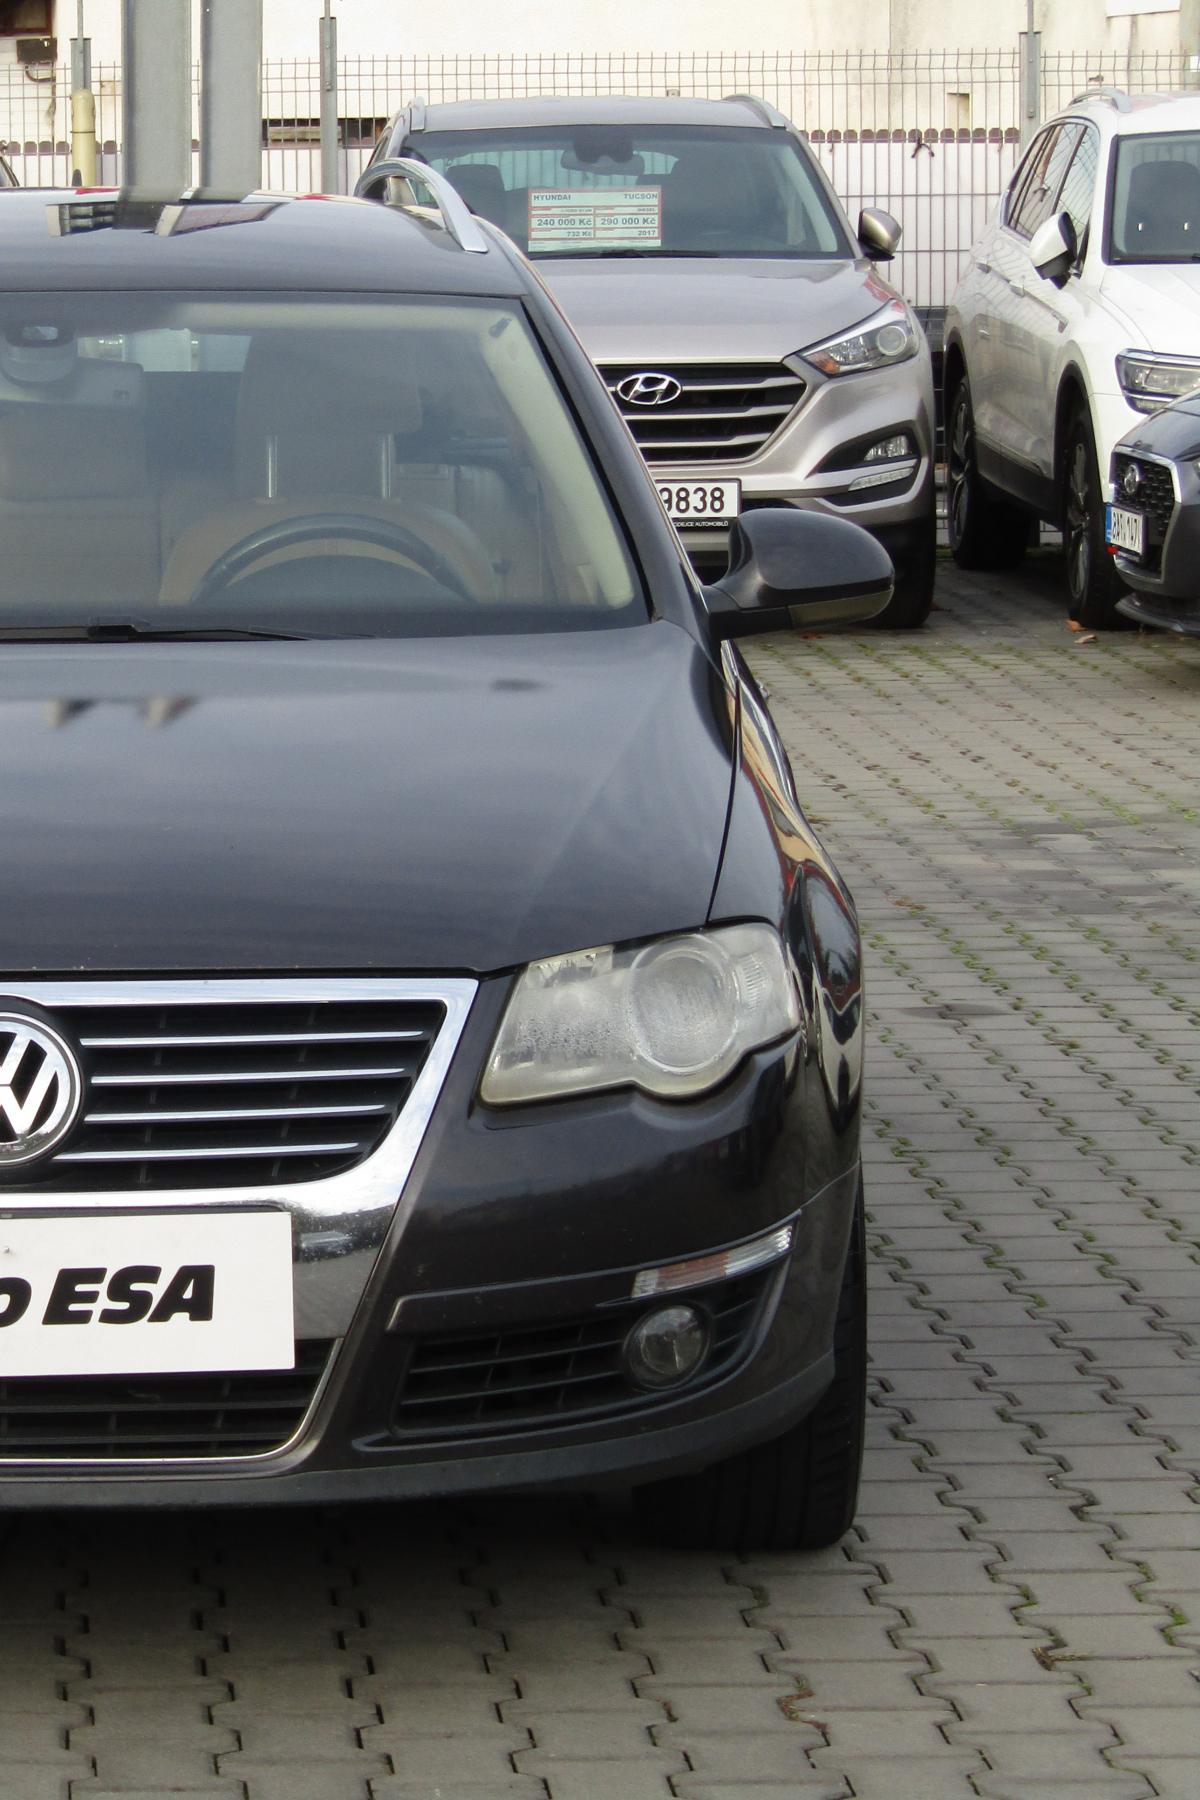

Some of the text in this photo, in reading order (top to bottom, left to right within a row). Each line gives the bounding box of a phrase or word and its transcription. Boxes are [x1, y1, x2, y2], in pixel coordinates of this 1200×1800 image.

[537, 217, 592, 226] 240 000 Kč
[600, 216, 656, 225] 290 000 Kč
[659, 487, 725, 513] 9838
[42, 1264, 216, 1326] ESA
